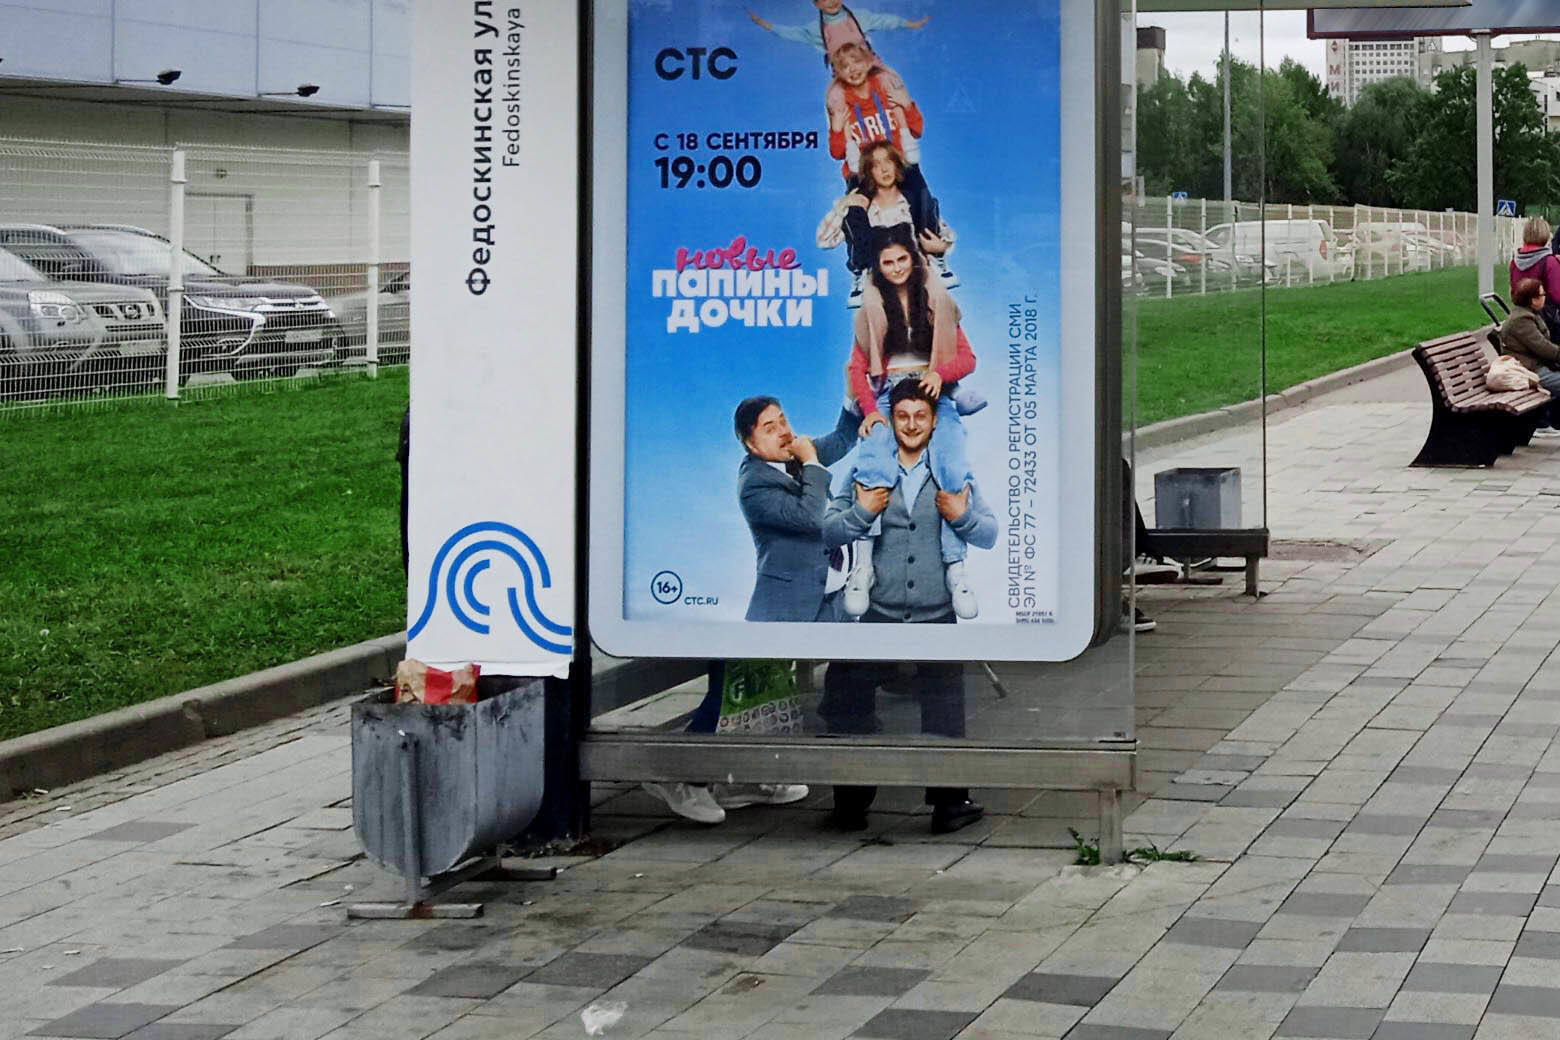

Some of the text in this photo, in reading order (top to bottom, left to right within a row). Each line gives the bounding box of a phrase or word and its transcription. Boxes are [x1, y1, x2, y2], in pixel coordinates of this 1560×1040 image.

[655, 47, 738, 81] СТС
[502, 8, 525, 167] Fedoskinskaya
[654, 131, 819, 151] С 18 СЕНТЯБРЯ
[465, 48, 494, 296] Федоскинская
[655, 155, 762, 189] 19:00
[1008, 303, 1022, 339] СМИ
[1024, 308, 1038, 341] 2018
[1024, 345, 1038, 396] МАРТА
[1008, 343, 1023, 452] РЕГИСТРАЦИИ
[1024, 400, 1037, 420] 05
[1024, 424, 1037, 446] ОТ
[1024, 451, 1038, 494] 72433
[1024, 513, 1037, 530] 77
[1008, 475, 1023, 608] СВИДЕТЕЛЬСТВО
[1024, 534, 1037, 560] ФС
[657, 581, 678, 594] 16+
[1024, 587, 1037, 608] ЭЛ
